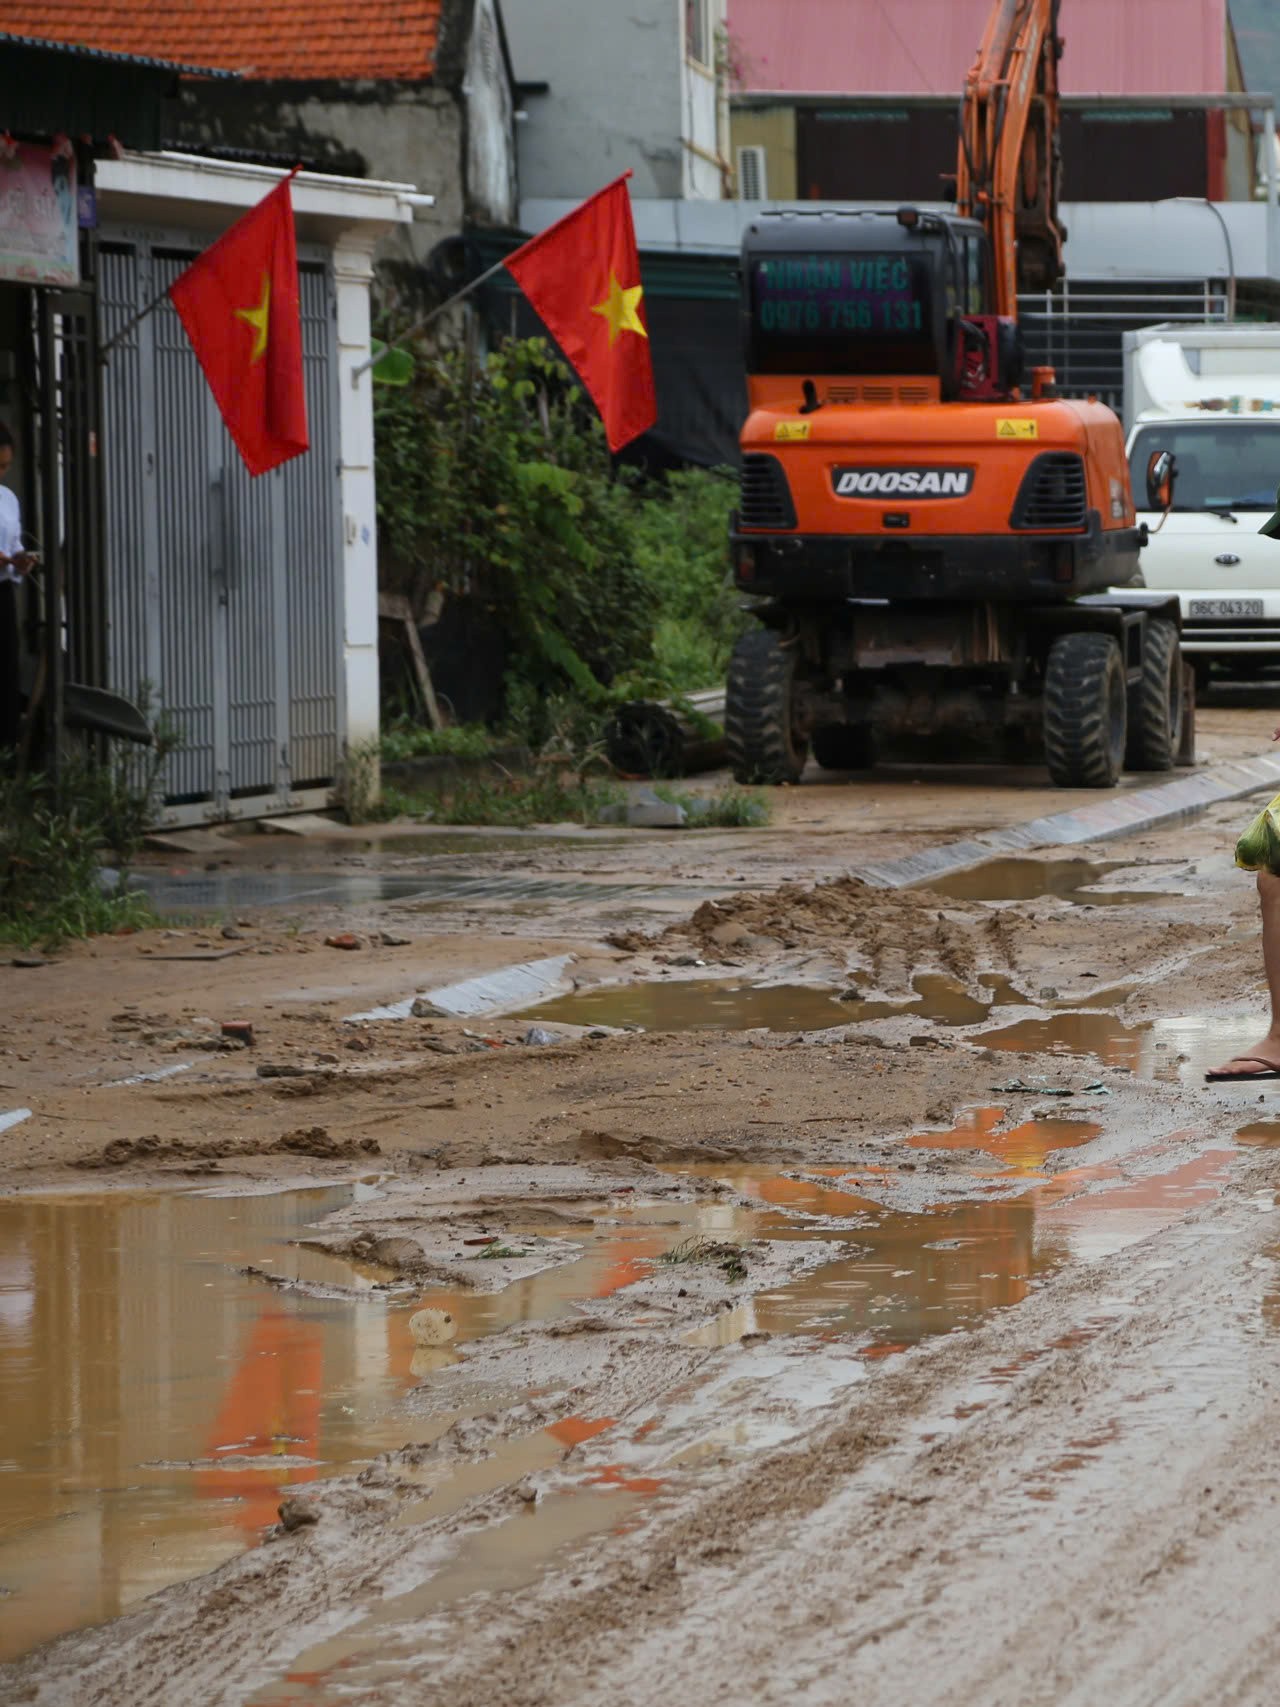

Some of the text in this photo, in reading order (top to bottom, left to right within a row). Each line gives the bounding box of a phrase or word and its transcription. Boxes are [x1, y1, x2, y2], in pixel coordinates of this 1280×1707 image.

[765, 255, 910, 295] NHẬN VIỆC
[881, 299, 922, 330] 131
[836, 472, 968, 494] DOOSAN
